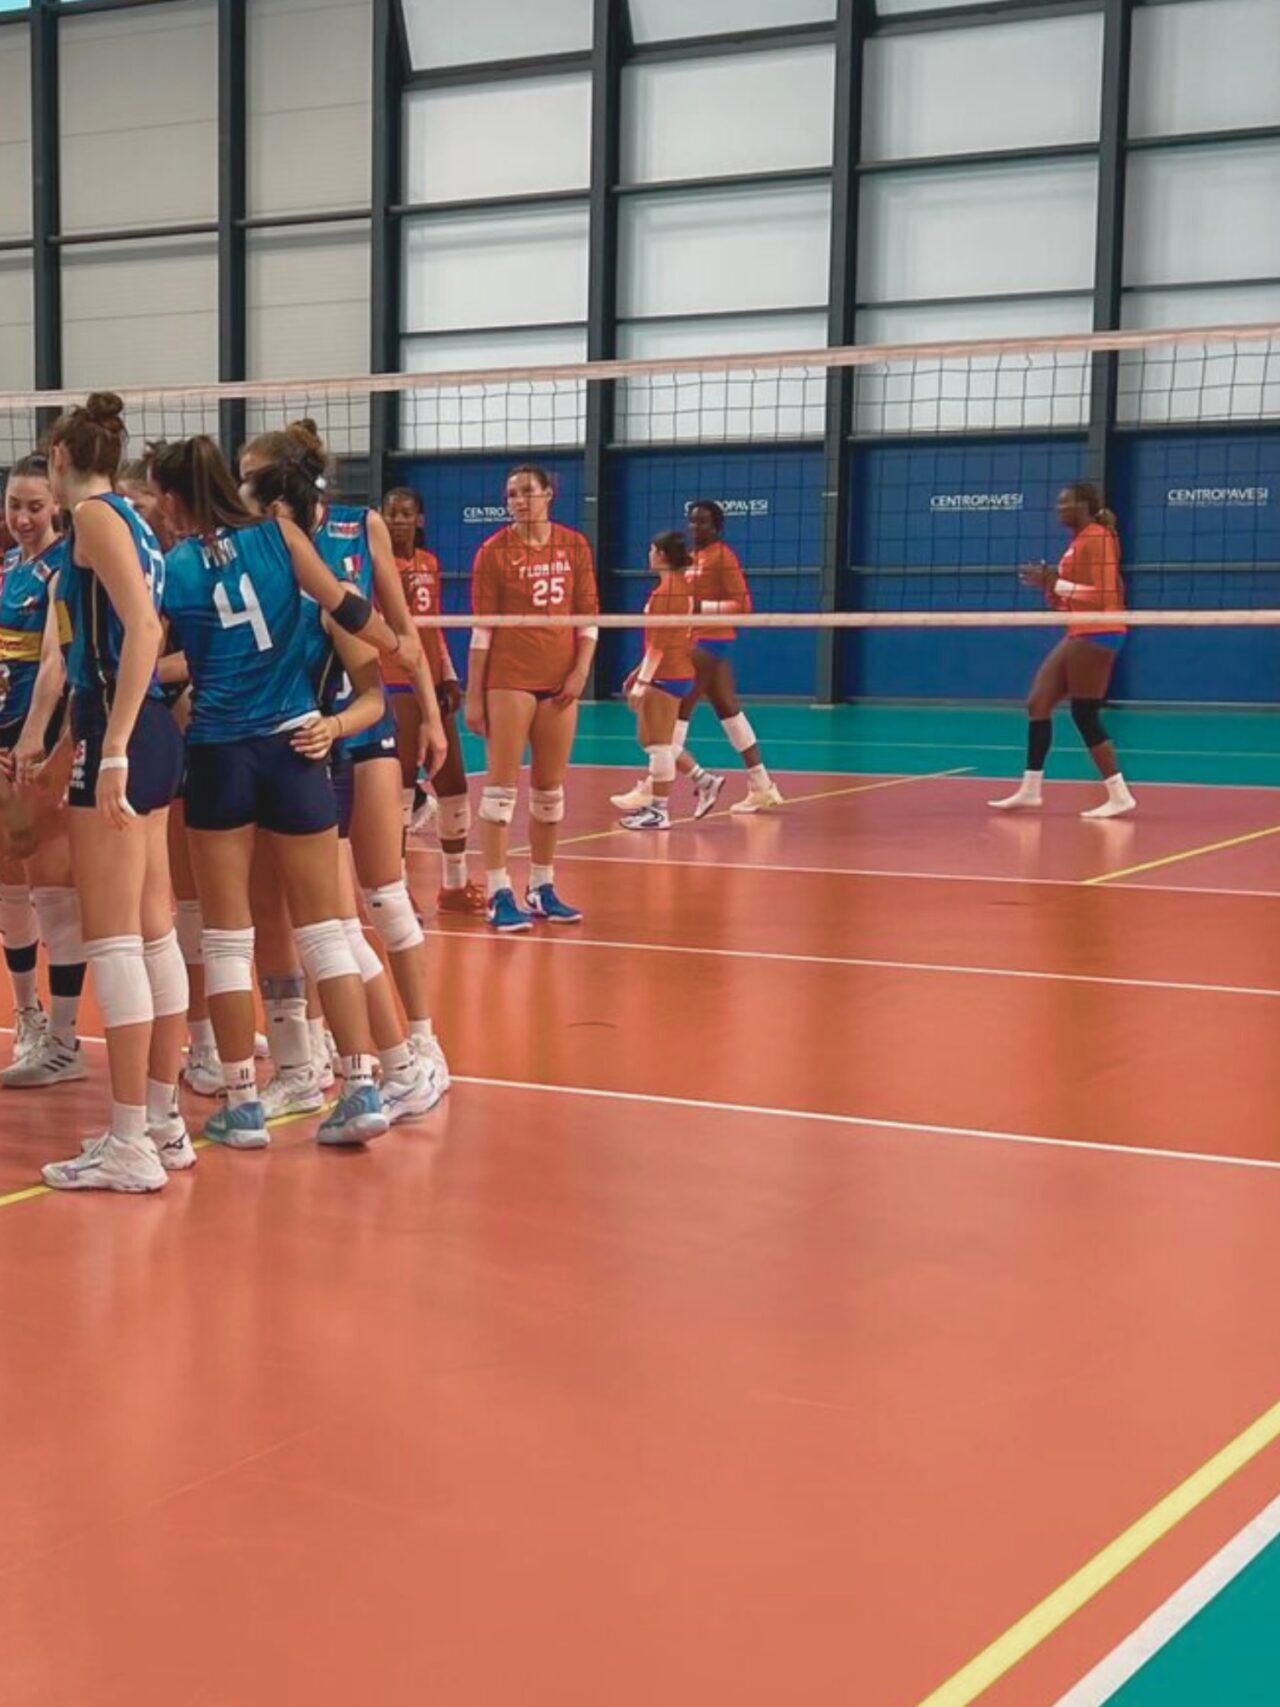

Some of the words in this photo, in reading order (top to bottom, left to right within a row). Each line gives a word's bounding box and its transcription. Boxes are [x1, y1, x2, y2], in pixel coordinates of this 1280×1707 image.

[930, 493, 1023, 508] CENTROPAVESI
[1168, 488, 1268, 501] CENTROPAVESI
[463, 506, 507, 518] CENTRO
[519, 560, 571, 580] FLORIDA
[416, 587, 431, 612] 9
[532, 577, 565, 606] 25
[213, 572, 274, 652] 4
